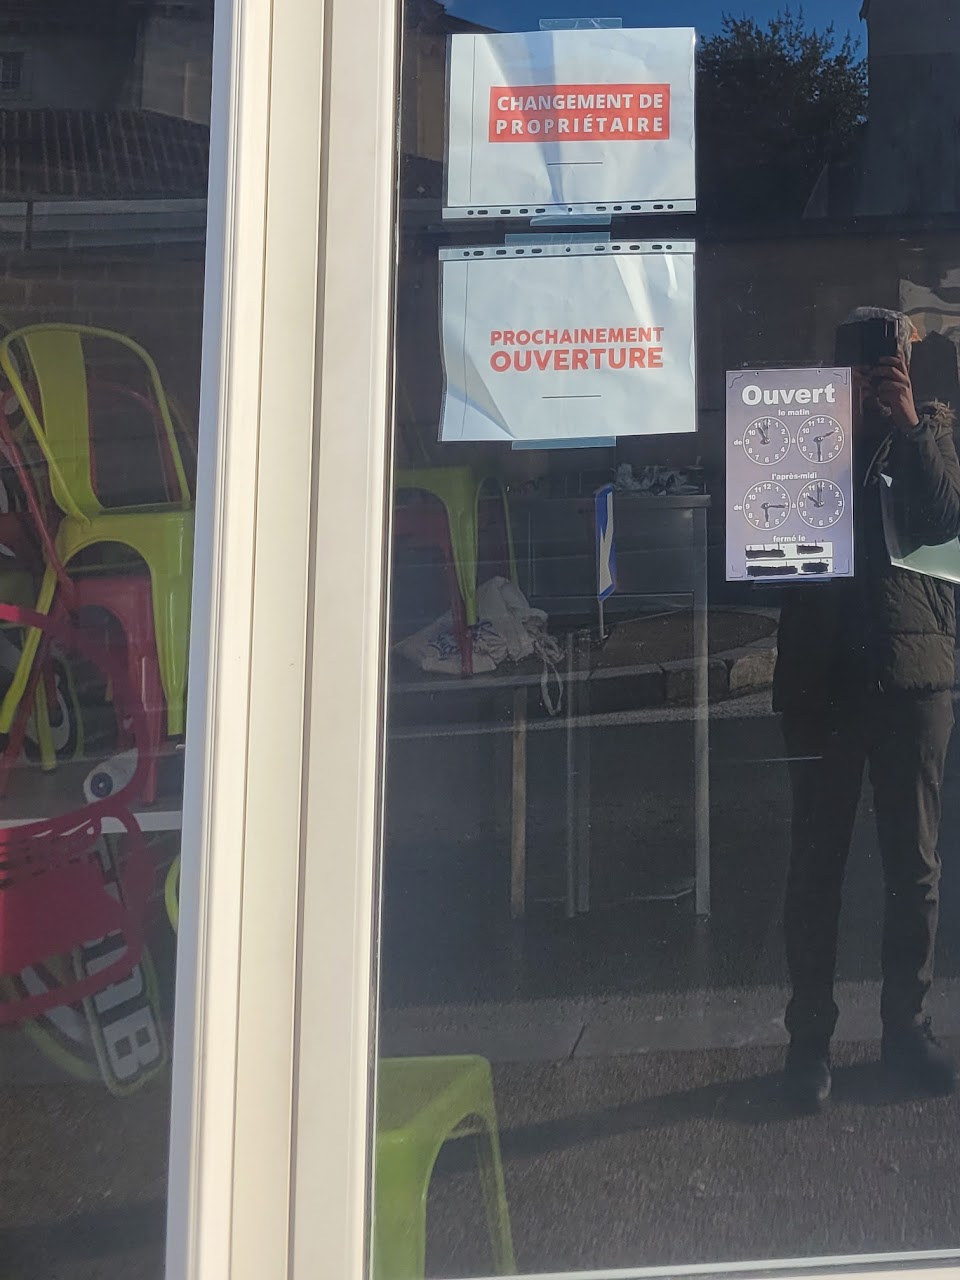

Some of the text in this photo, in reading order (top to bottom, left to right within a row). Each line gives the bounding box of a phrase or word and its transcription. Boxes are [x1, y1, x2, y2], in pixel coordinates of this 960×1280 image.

[497, 93, 663, 111] CHANGEMENT DE
[496, 114, 663, 135] PROPRIÉTAIRE
[490, 327, 664, 346] PROCHAINEMENT
[490, 347, 663, 372] OUVERTURE
[742, 383, 835, 405] Ouvert
[772, 472, 817, 481] l'après-midi
